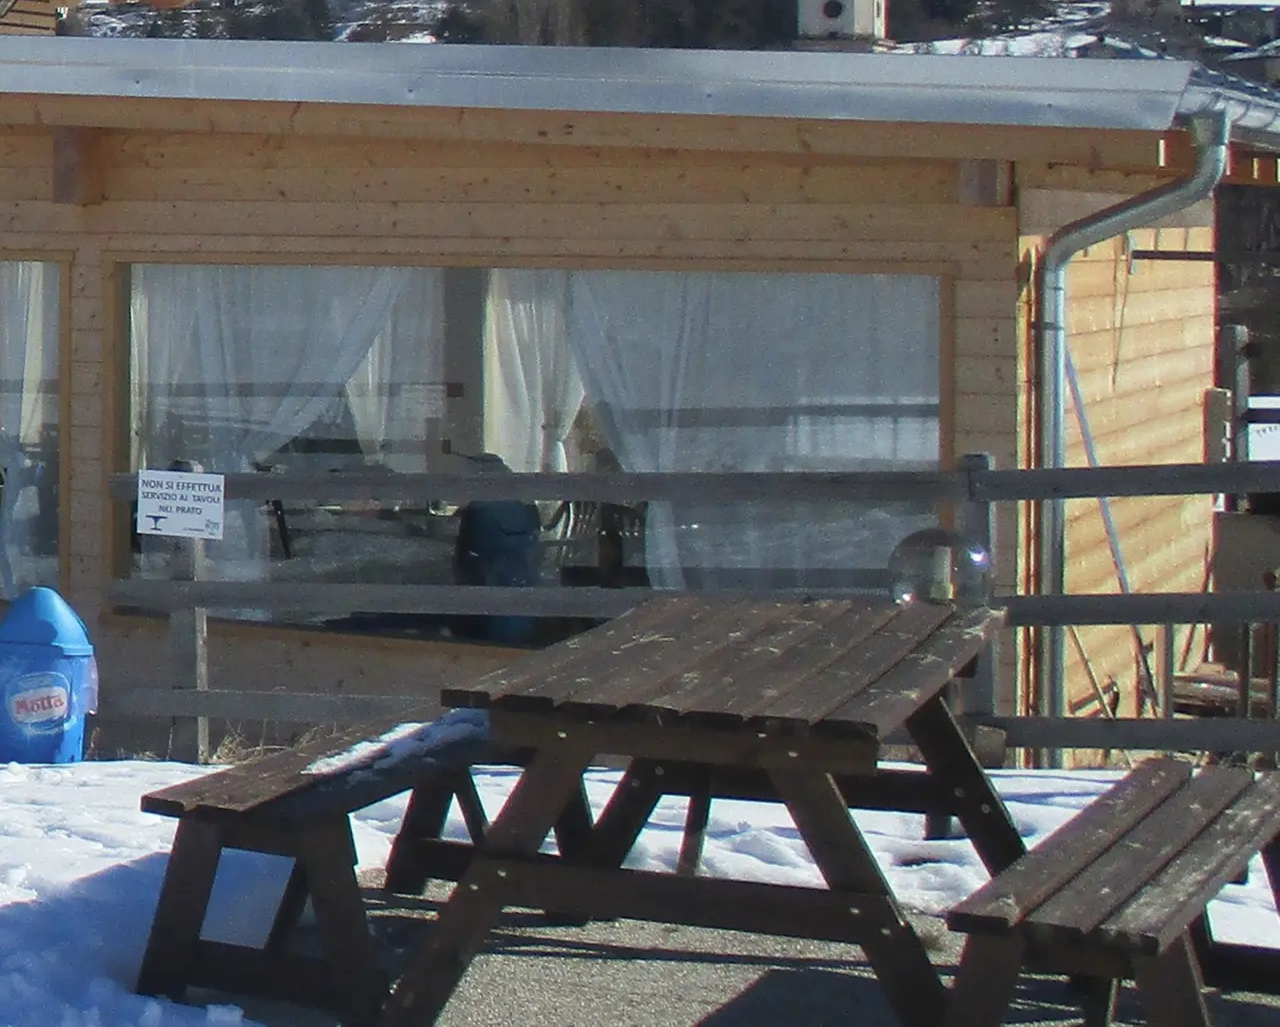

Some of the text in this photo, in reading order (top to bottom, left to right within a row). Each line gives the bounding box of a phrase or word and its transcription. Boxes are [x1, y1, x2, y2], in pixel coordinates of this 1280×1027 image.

[141, 479, 222, 493] NON SI EFFETTUA
[141, 491, 178, 502] SERVIZIO
[192, 495, 220, 504] TAVOLI
[158, 505, 203, 515] NEL PRATO
[13, 694, 65, 715] Motta
